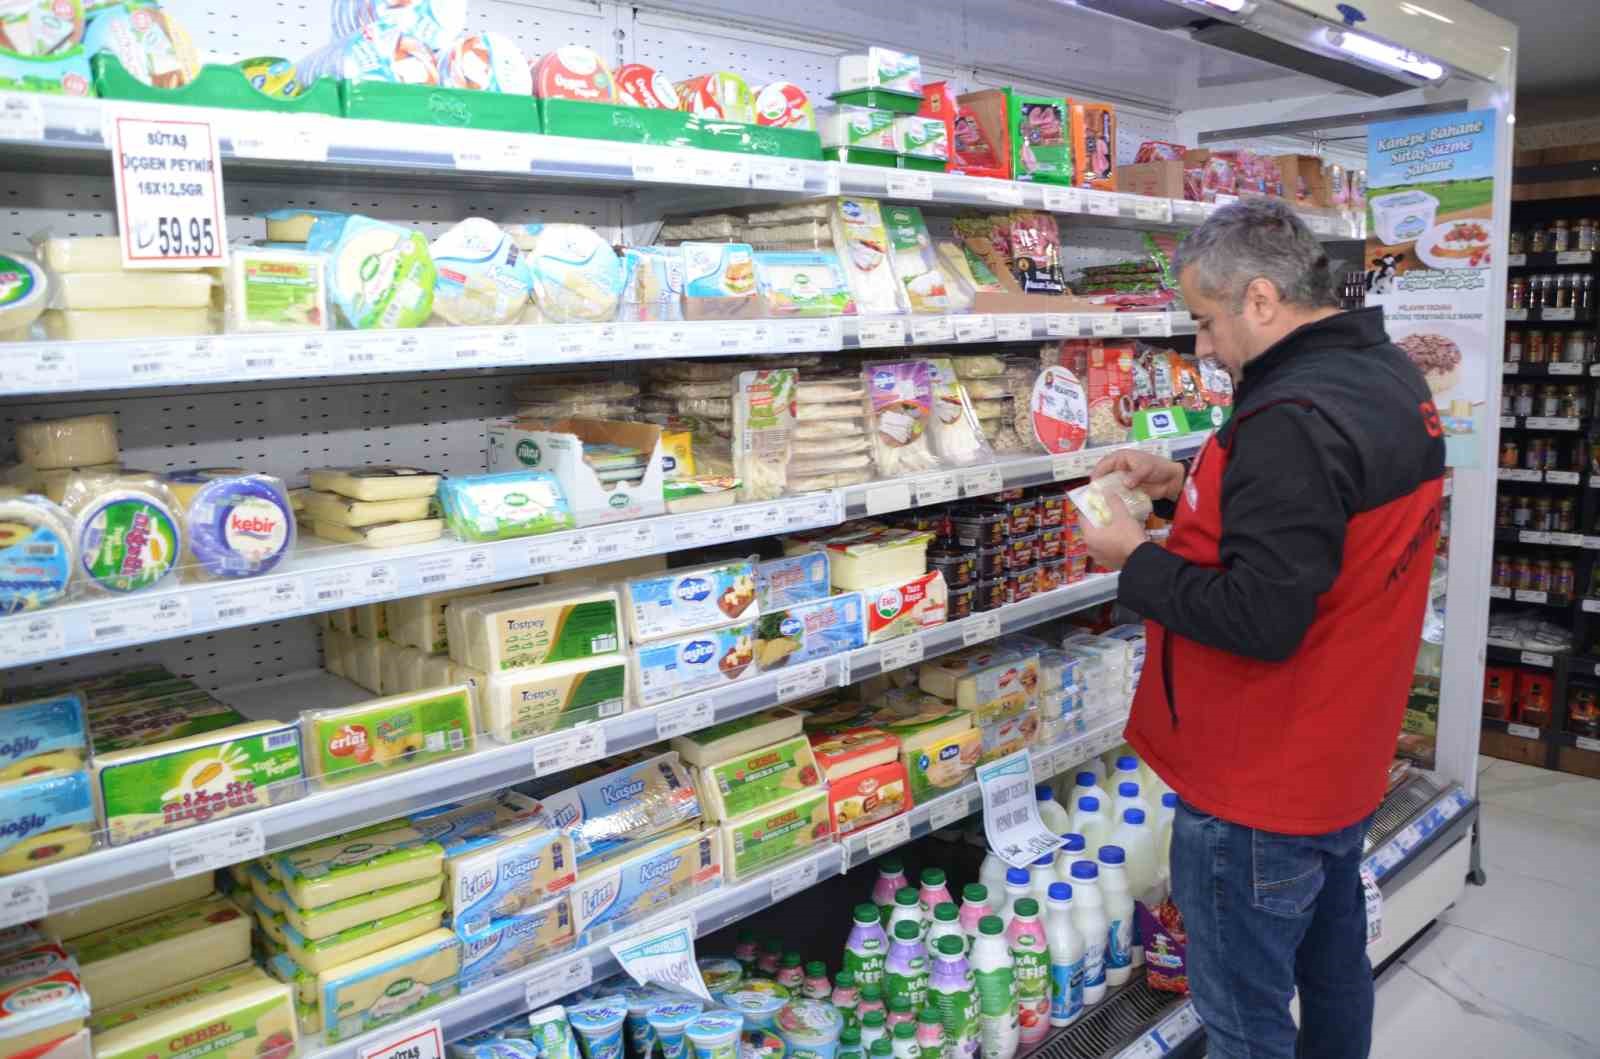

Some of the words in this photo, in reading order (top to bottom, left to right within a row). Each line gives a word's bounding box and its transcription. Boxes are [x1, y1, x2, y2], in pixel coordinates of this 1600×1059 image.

[147, 131, 188, 149] SÜTAŞ
[1377, 132, 1425, 152] Kanepe
[1429, 120, 1483, 141] Bahane
[159, 216, 214, 256] 59.95
[232, 513, 276, 533] kebir
[507, 619, 545, 631] Tostpey
[601, 779, 645, 806] Kaşar
[502, 857, 541, 881] Kaşar
[640, 854, 681, 884] Kaşar
[169, 1020, 232, 1052] CEBEL
